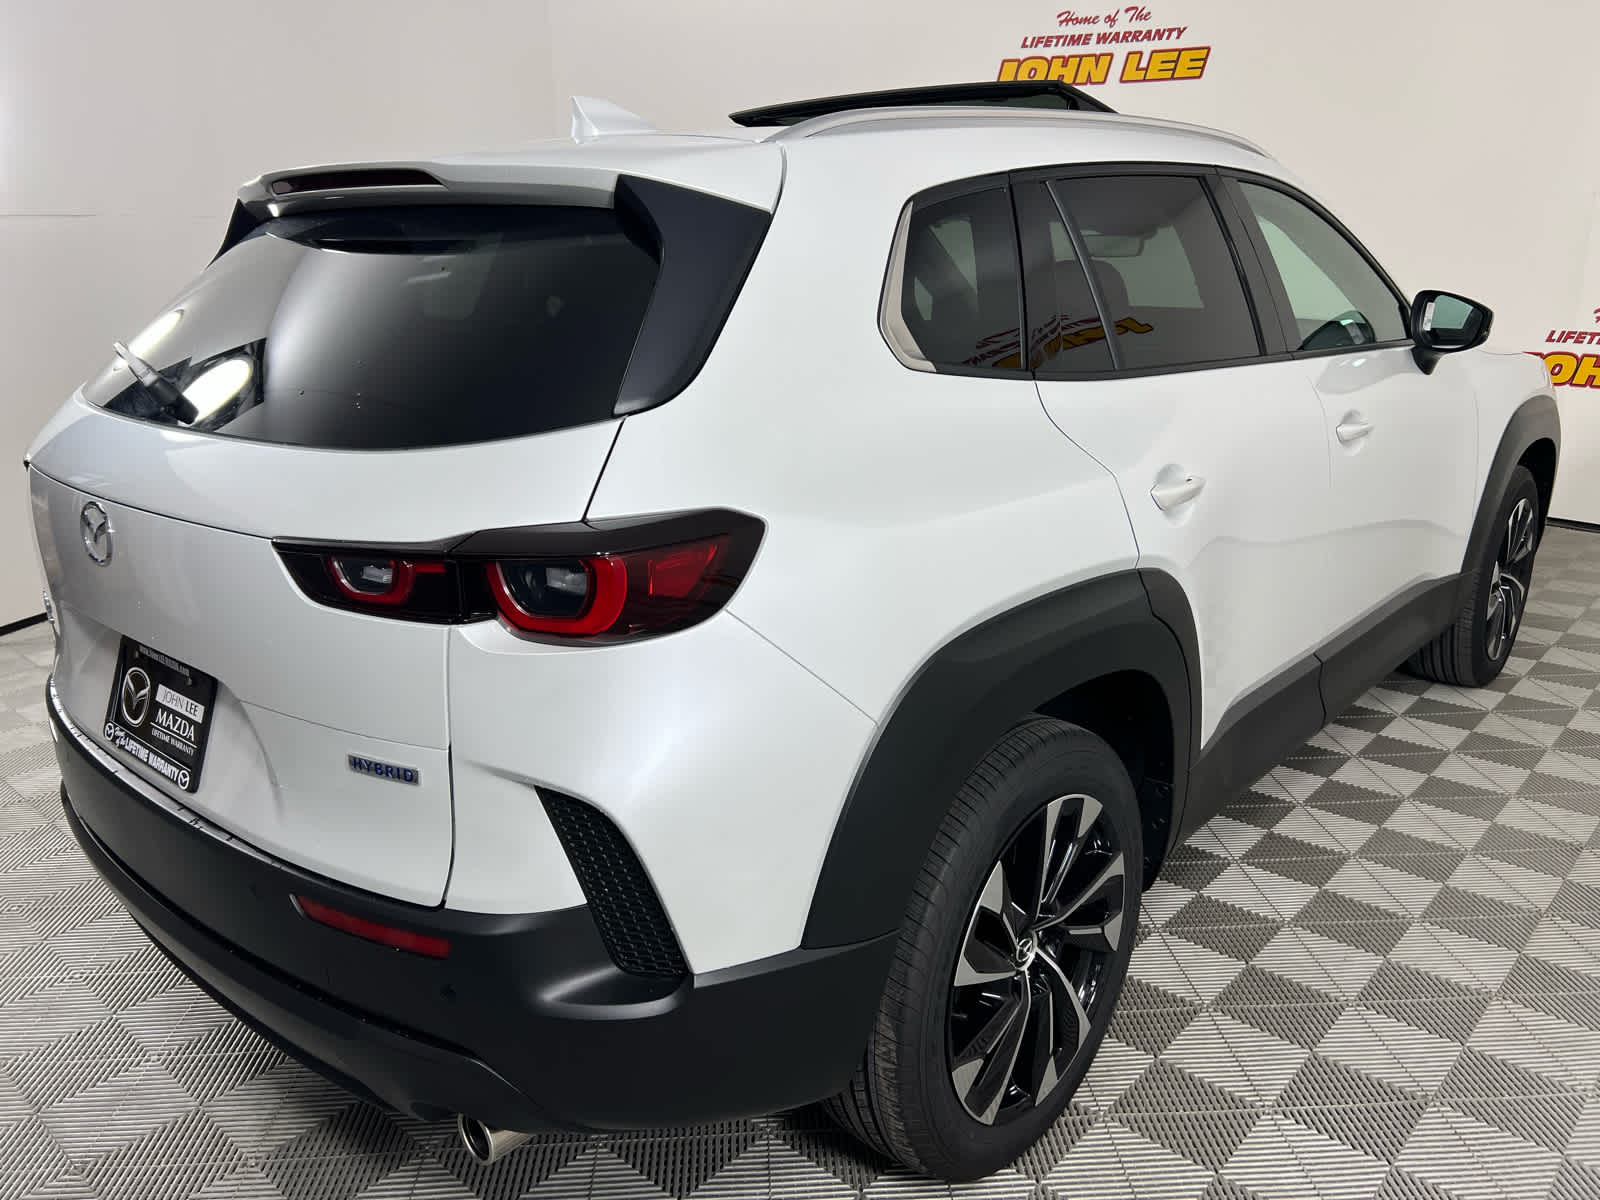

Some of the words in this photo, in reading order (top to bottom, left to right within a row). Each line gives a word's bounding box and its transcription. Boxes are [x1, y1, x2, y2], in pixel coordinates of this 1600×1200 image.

[1056, 10, 1100, 27] Home
[1103, 8, 1120, 28] of
[1124, 6, 1152, 23] The
[1020, 33, 1094, 49] LIFETIME
[1095, 26, 1188, 45] WARRANTY
[1119, 46, 1212, 83] LEE
[1521, 350, 1600, 389] OH
[163, 689, 183, 709] JOHN
[185, 700, 199, 717] LEE
[155, 707, 195, 742] MAZDA
[125, 736, 149, 762] LIFETIME
[148, 751, 180, 782] WARRANTY
[352, 756, 414, 783] HYBRID
